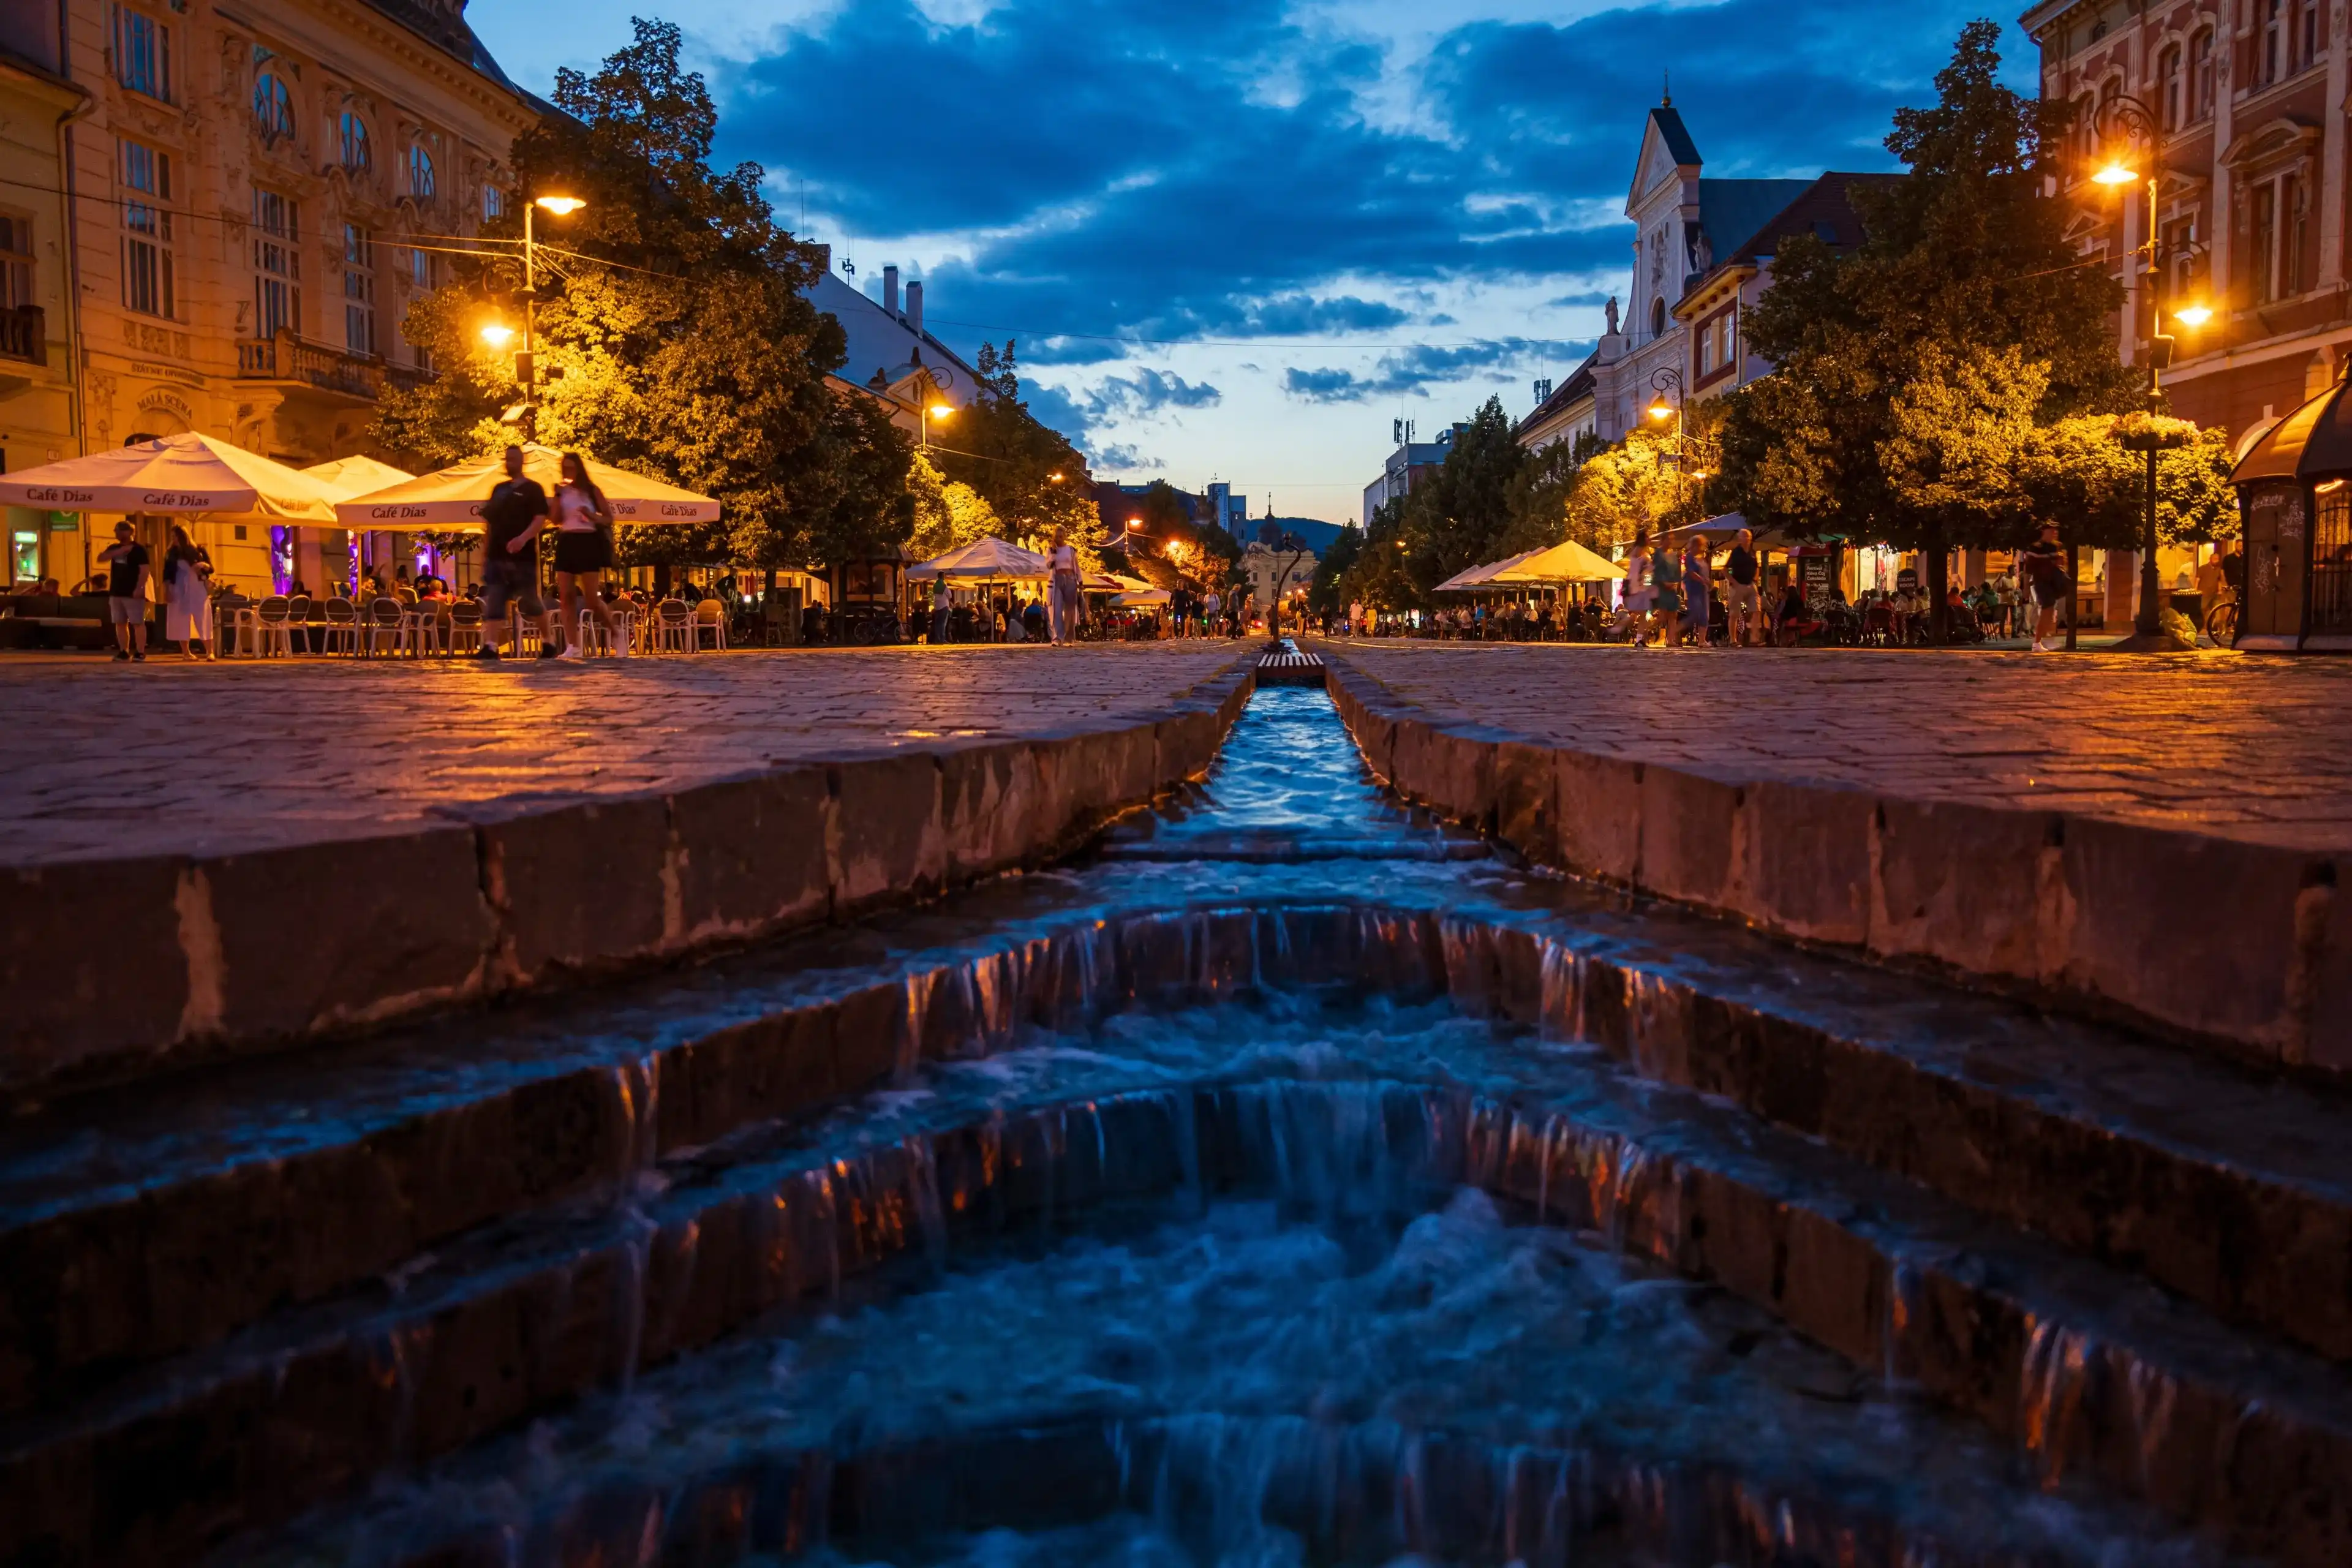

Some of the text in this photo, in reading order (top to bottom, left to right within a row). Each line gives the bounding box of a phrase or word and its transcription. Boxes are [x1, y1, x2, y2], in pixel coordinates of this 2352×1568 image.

[26, 488, 94, 502] Café Dias
[143, 493, 209, 506] Café Dias
[371, 507, 426, 519] Café Dias
[616, 503, 636, 514] Dias
[679, 506, 697, 516] Dias
